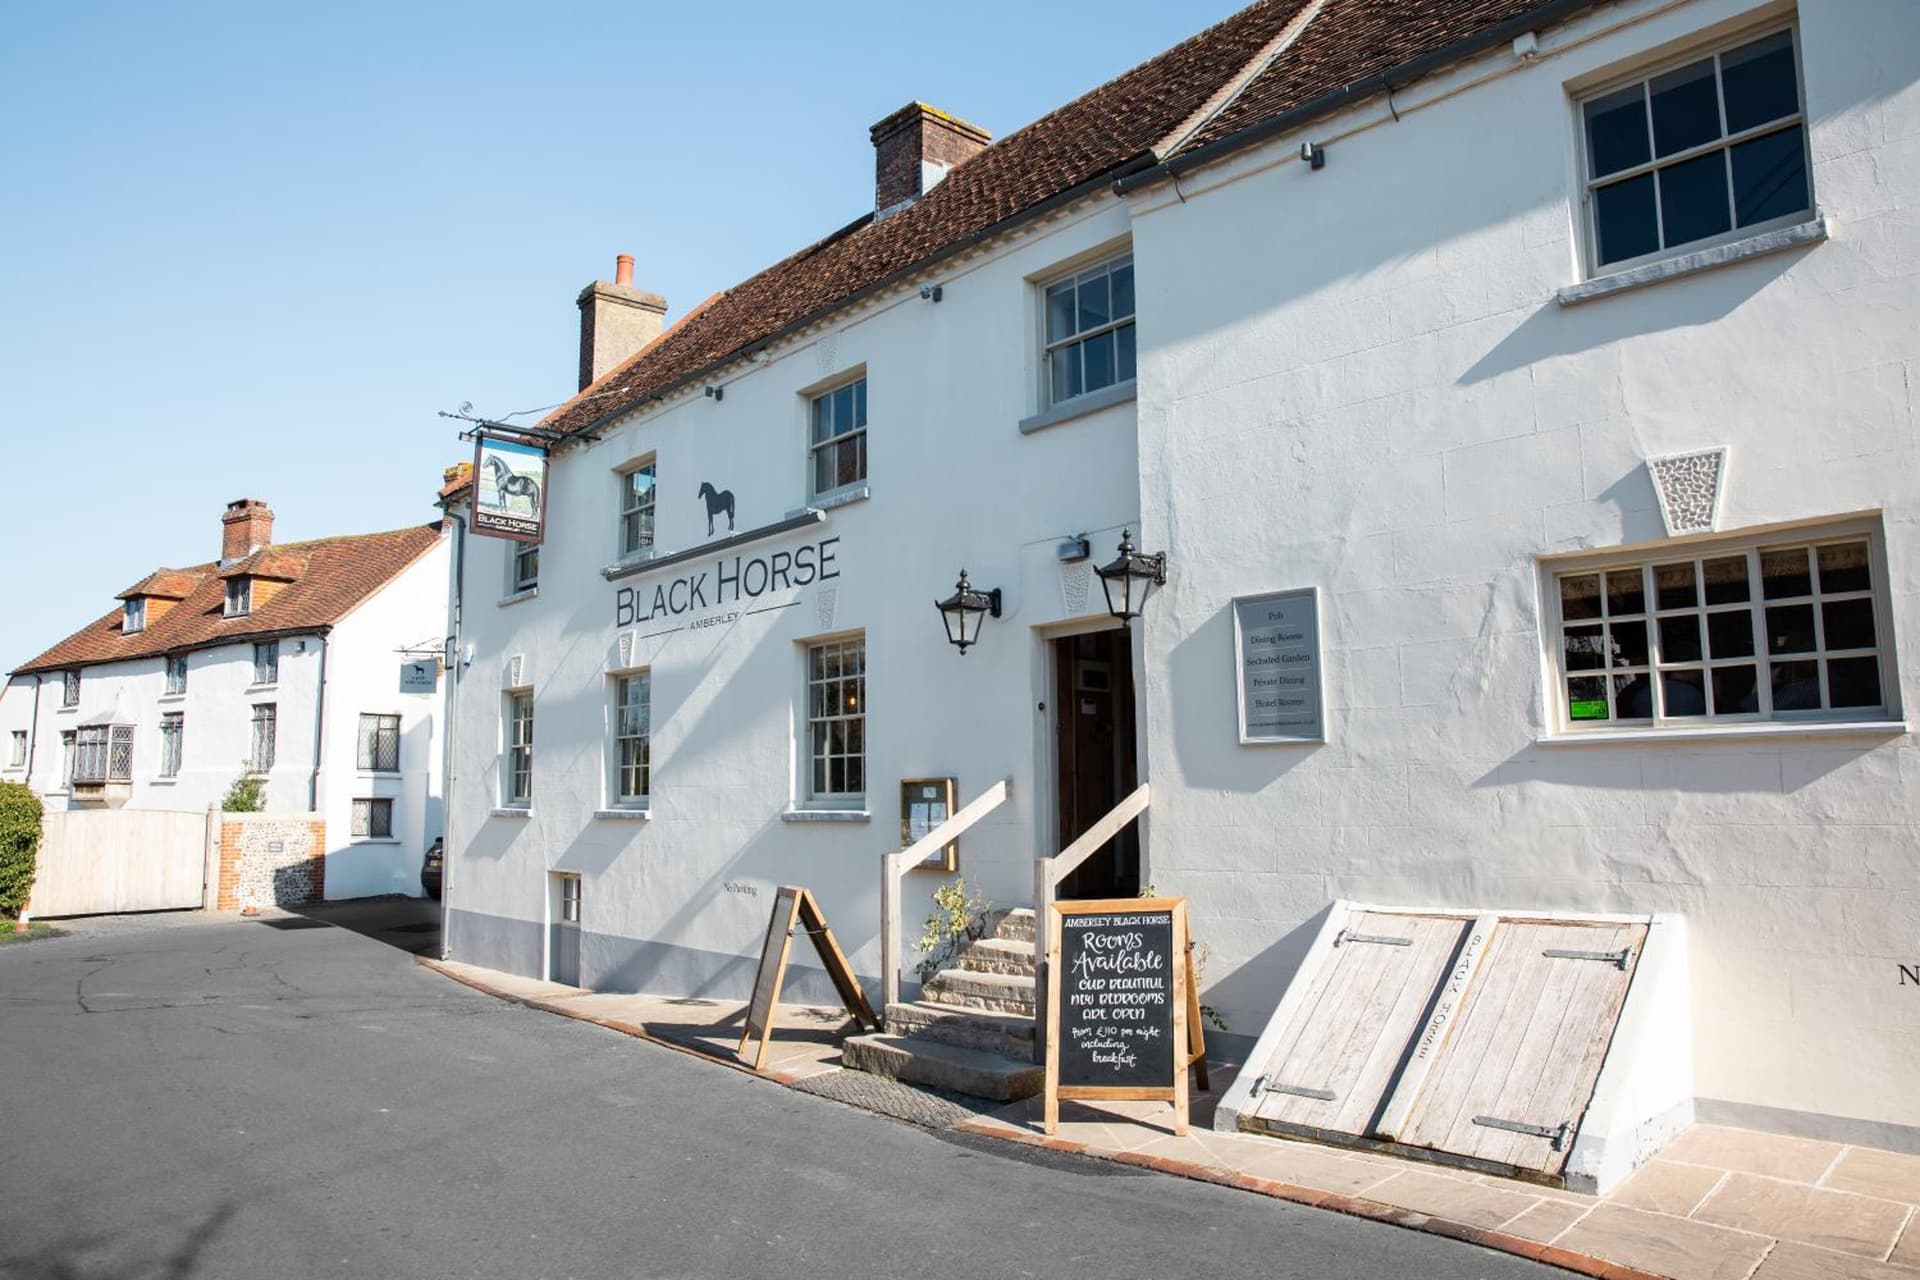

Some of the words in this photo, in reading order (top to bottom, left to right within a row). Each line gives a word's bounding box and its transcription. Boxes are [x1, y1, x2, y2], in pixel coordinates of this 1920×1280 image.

[478, 514, 507, 526] BLACK
[508, 519, 537, 531] HORSE
[616, 573, 707, 628] BLACK
[717, 535, 840, 604] HORSE
[689, 611, 741, 632] AMBERLEY
[1268, 611, 1284, 621] Pub
[1251, 635, 1276, 645] Dining
[1278, 632, 1304, 642] Rooms
[1247, 655, 1280, 665] Secluded
[1281, 653, 1311, 663] Garden
[1253, 679, 1277, 688] Private
[1279, 676, 1305, 685] Dining
[1255, 699, 1276, 709] Hotel
[1065, 918, 1111, 928] AMBERLEY
[1113, 916, 1140, 926] BLACK
[1142, 915, 1170, 925] HORSE
[1081, 932, 1143, 954] Rooms
[1071, 949, 1163, 979] Available
[1078, 978, 1106, 990] OUR
[1109, 977, 1165, 990] BEAUTIFUL
[1099, 992, 1165, 1005] BEDROOMS
[1082, 1008, 1108, 1020] ARE
[1072, 1027, 1092, 1039] from
[1095, 1026, 1118, 1038] £110
[1136, 1025, 1161, 1041] night
[1081, 1037, 1130, 1055] including
[1092, 1050, 1137, 1070] breakfast
